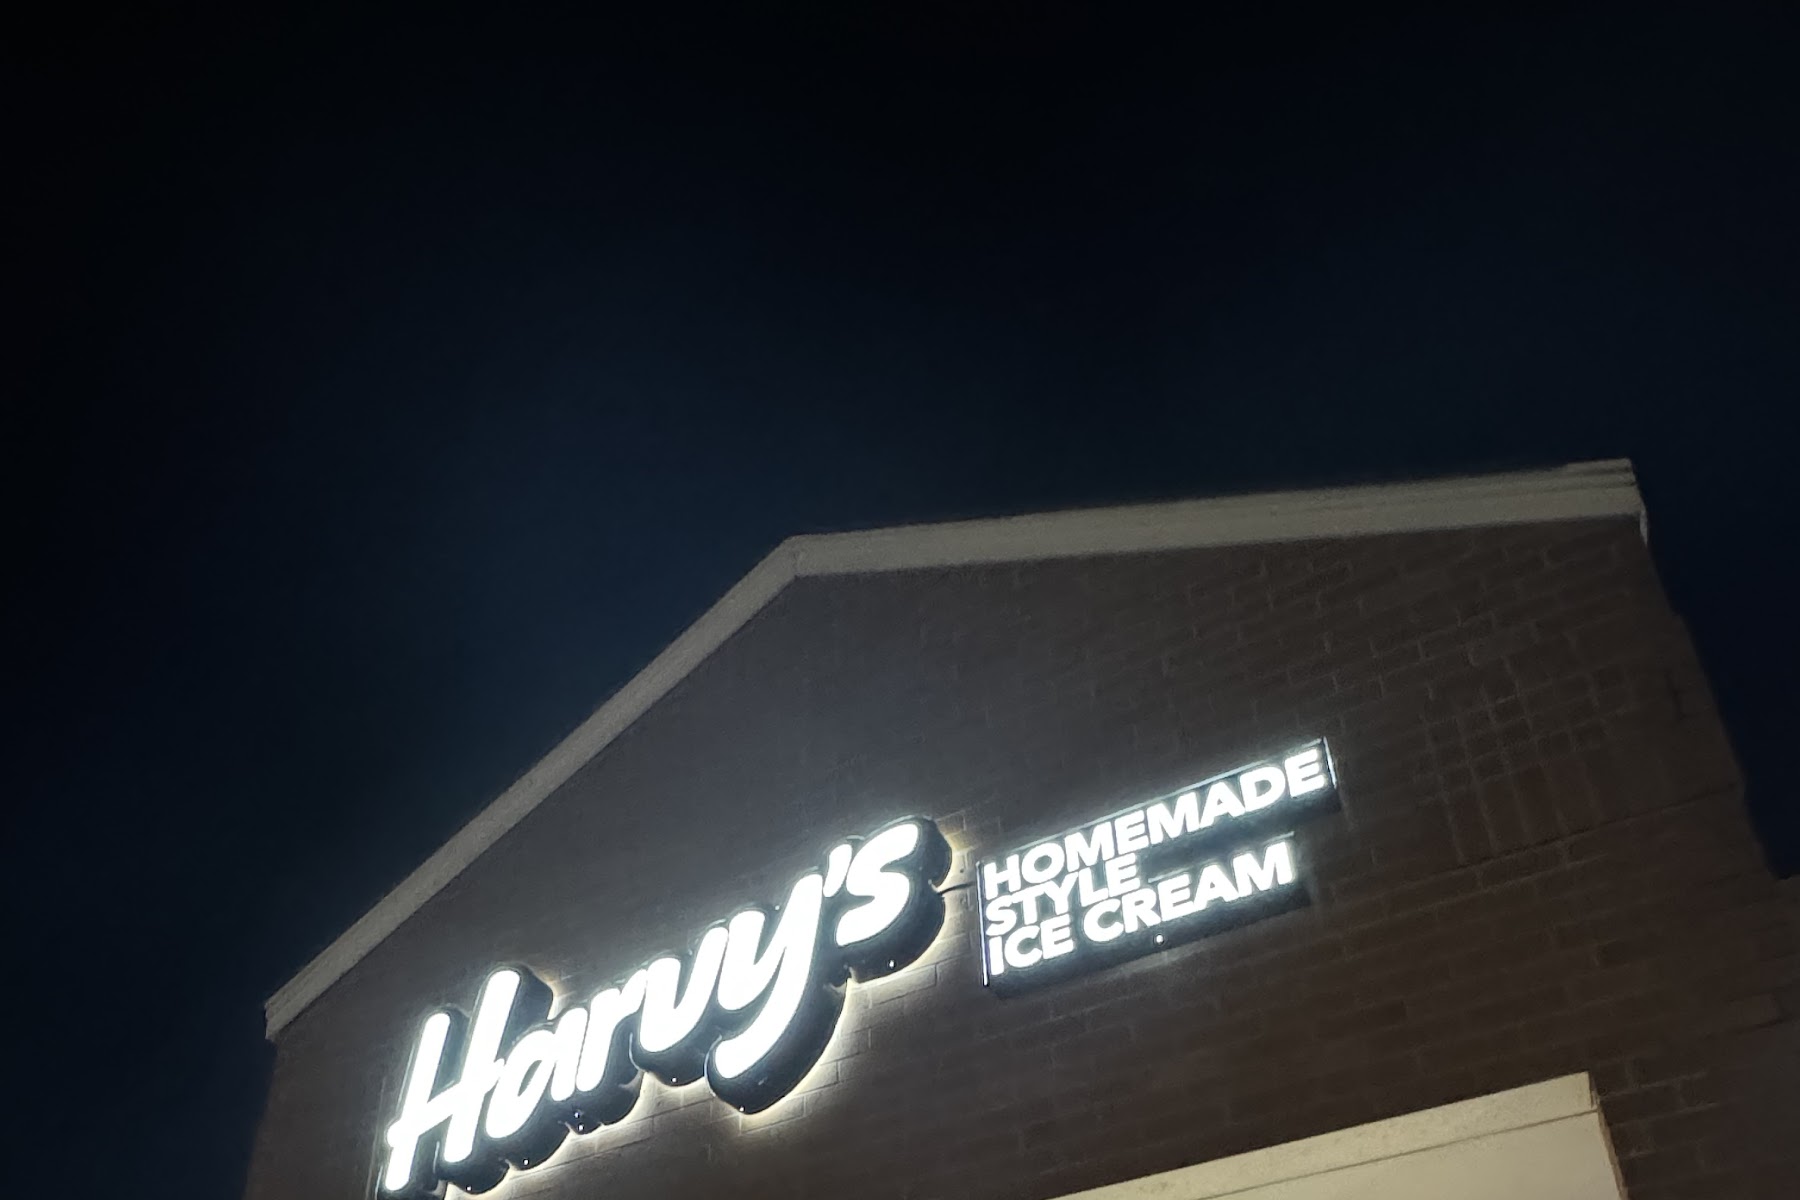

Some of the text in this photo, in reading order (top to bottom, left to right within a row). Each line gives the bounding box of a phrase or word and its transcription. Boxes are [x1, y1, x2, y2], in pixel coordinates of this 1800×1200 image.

[983, 748, 1326, 899] HOMEMADE
[986, 854, 1140, 936] STYLE
[987, 842, 1296, 976] ICE CREAM
[383, 821, 925, 1192] Harvy's
